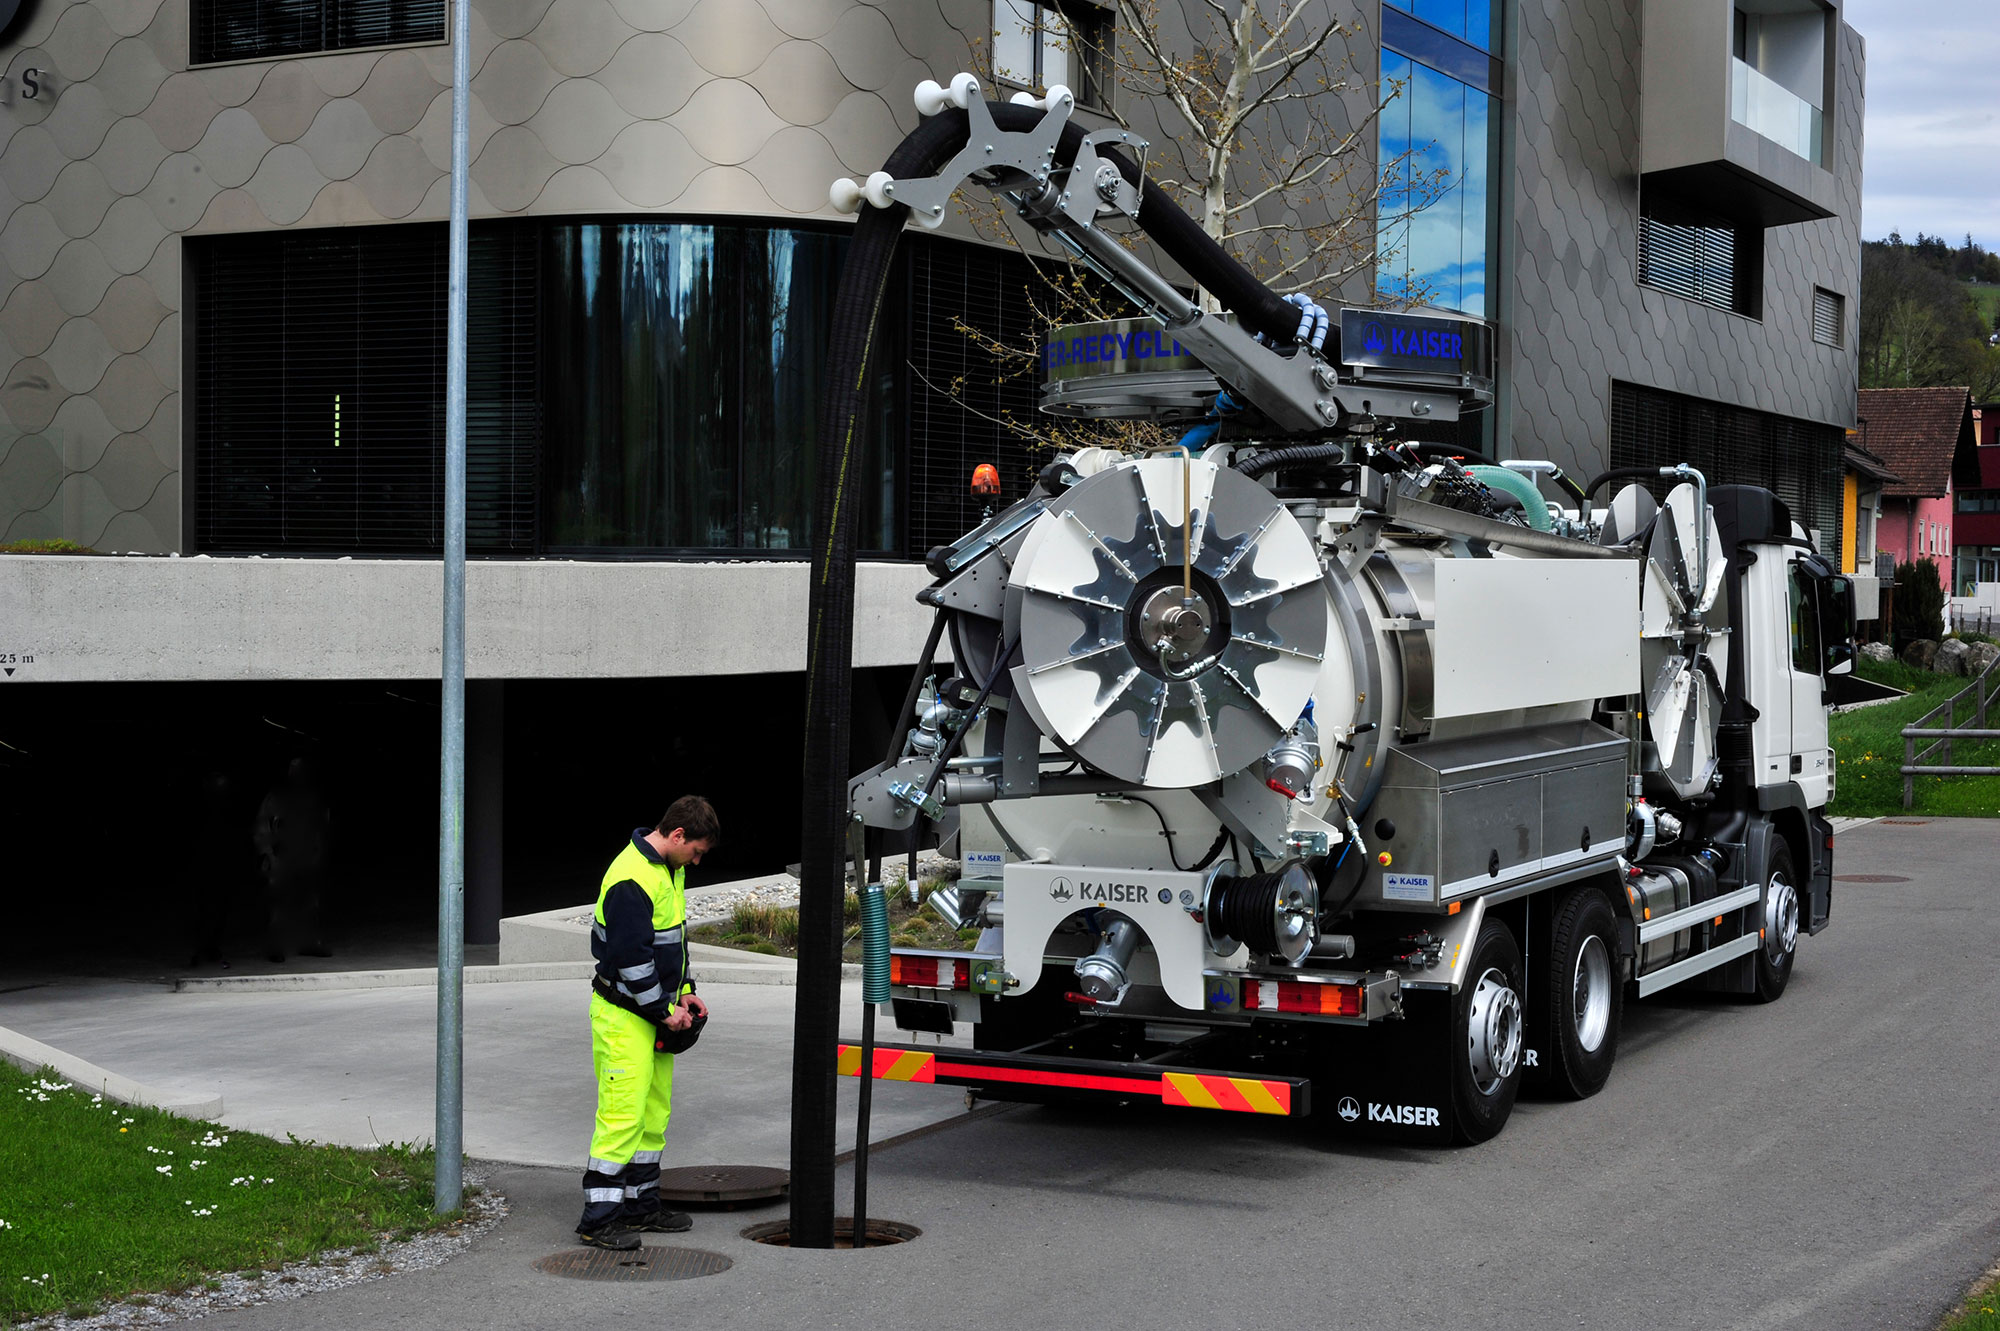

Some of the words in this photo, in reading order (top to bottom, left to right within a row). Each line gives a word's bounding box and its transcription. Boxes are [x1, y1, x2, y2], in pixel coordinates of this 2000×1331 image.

[22, 68, 39, 99] S
[1041, 330, 1191, 369] TER-RECYCLI
[1391, 327, 1463, 360] KAISER
[23, 655, 34, 663] m
[977, 854, 1001, 862] KAISER
[1080, 881, 1149, 904] KAISER
[1399, 877, 1428, 886] KAISER
[1522, 1048, 1539, 1067] R
[1367, 1102, 1441, 1127] KAISER
